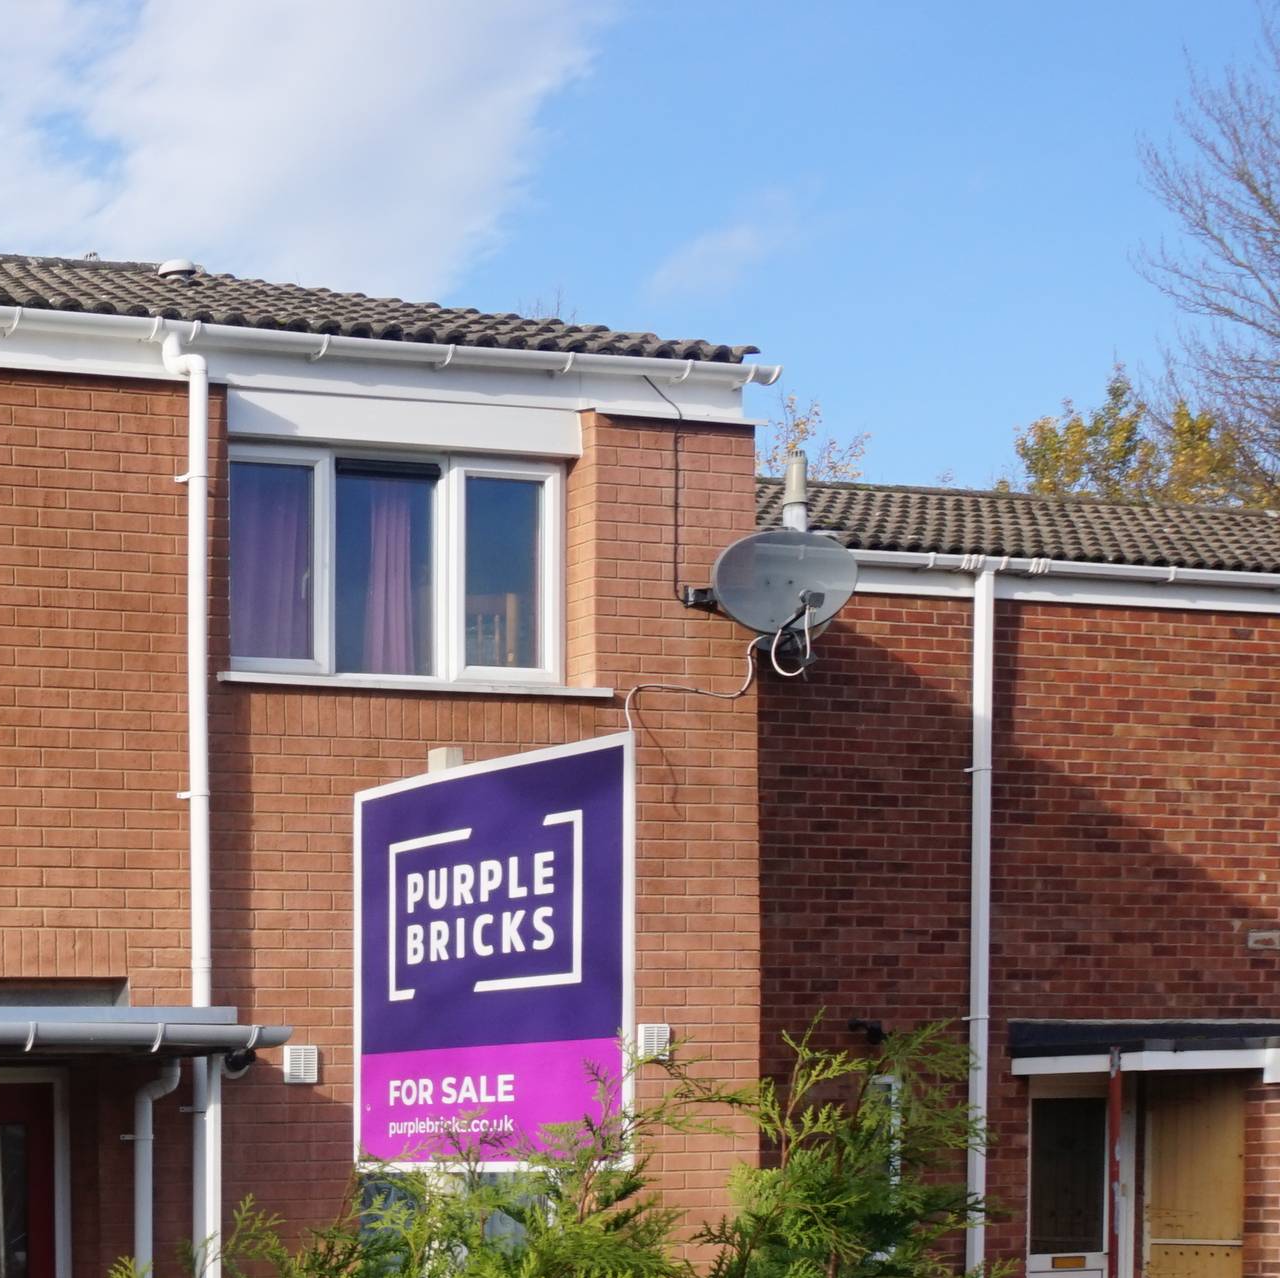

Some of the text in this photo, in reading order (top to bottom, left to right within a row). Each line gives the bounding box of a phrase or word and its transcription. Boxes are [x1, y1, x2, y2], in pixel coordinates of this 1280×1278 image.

[406, 850, 555, 914] PURPLE
[406, 906, 555, 965] BRICKS
[389, 1073, 515, 1106] FOR SALE
